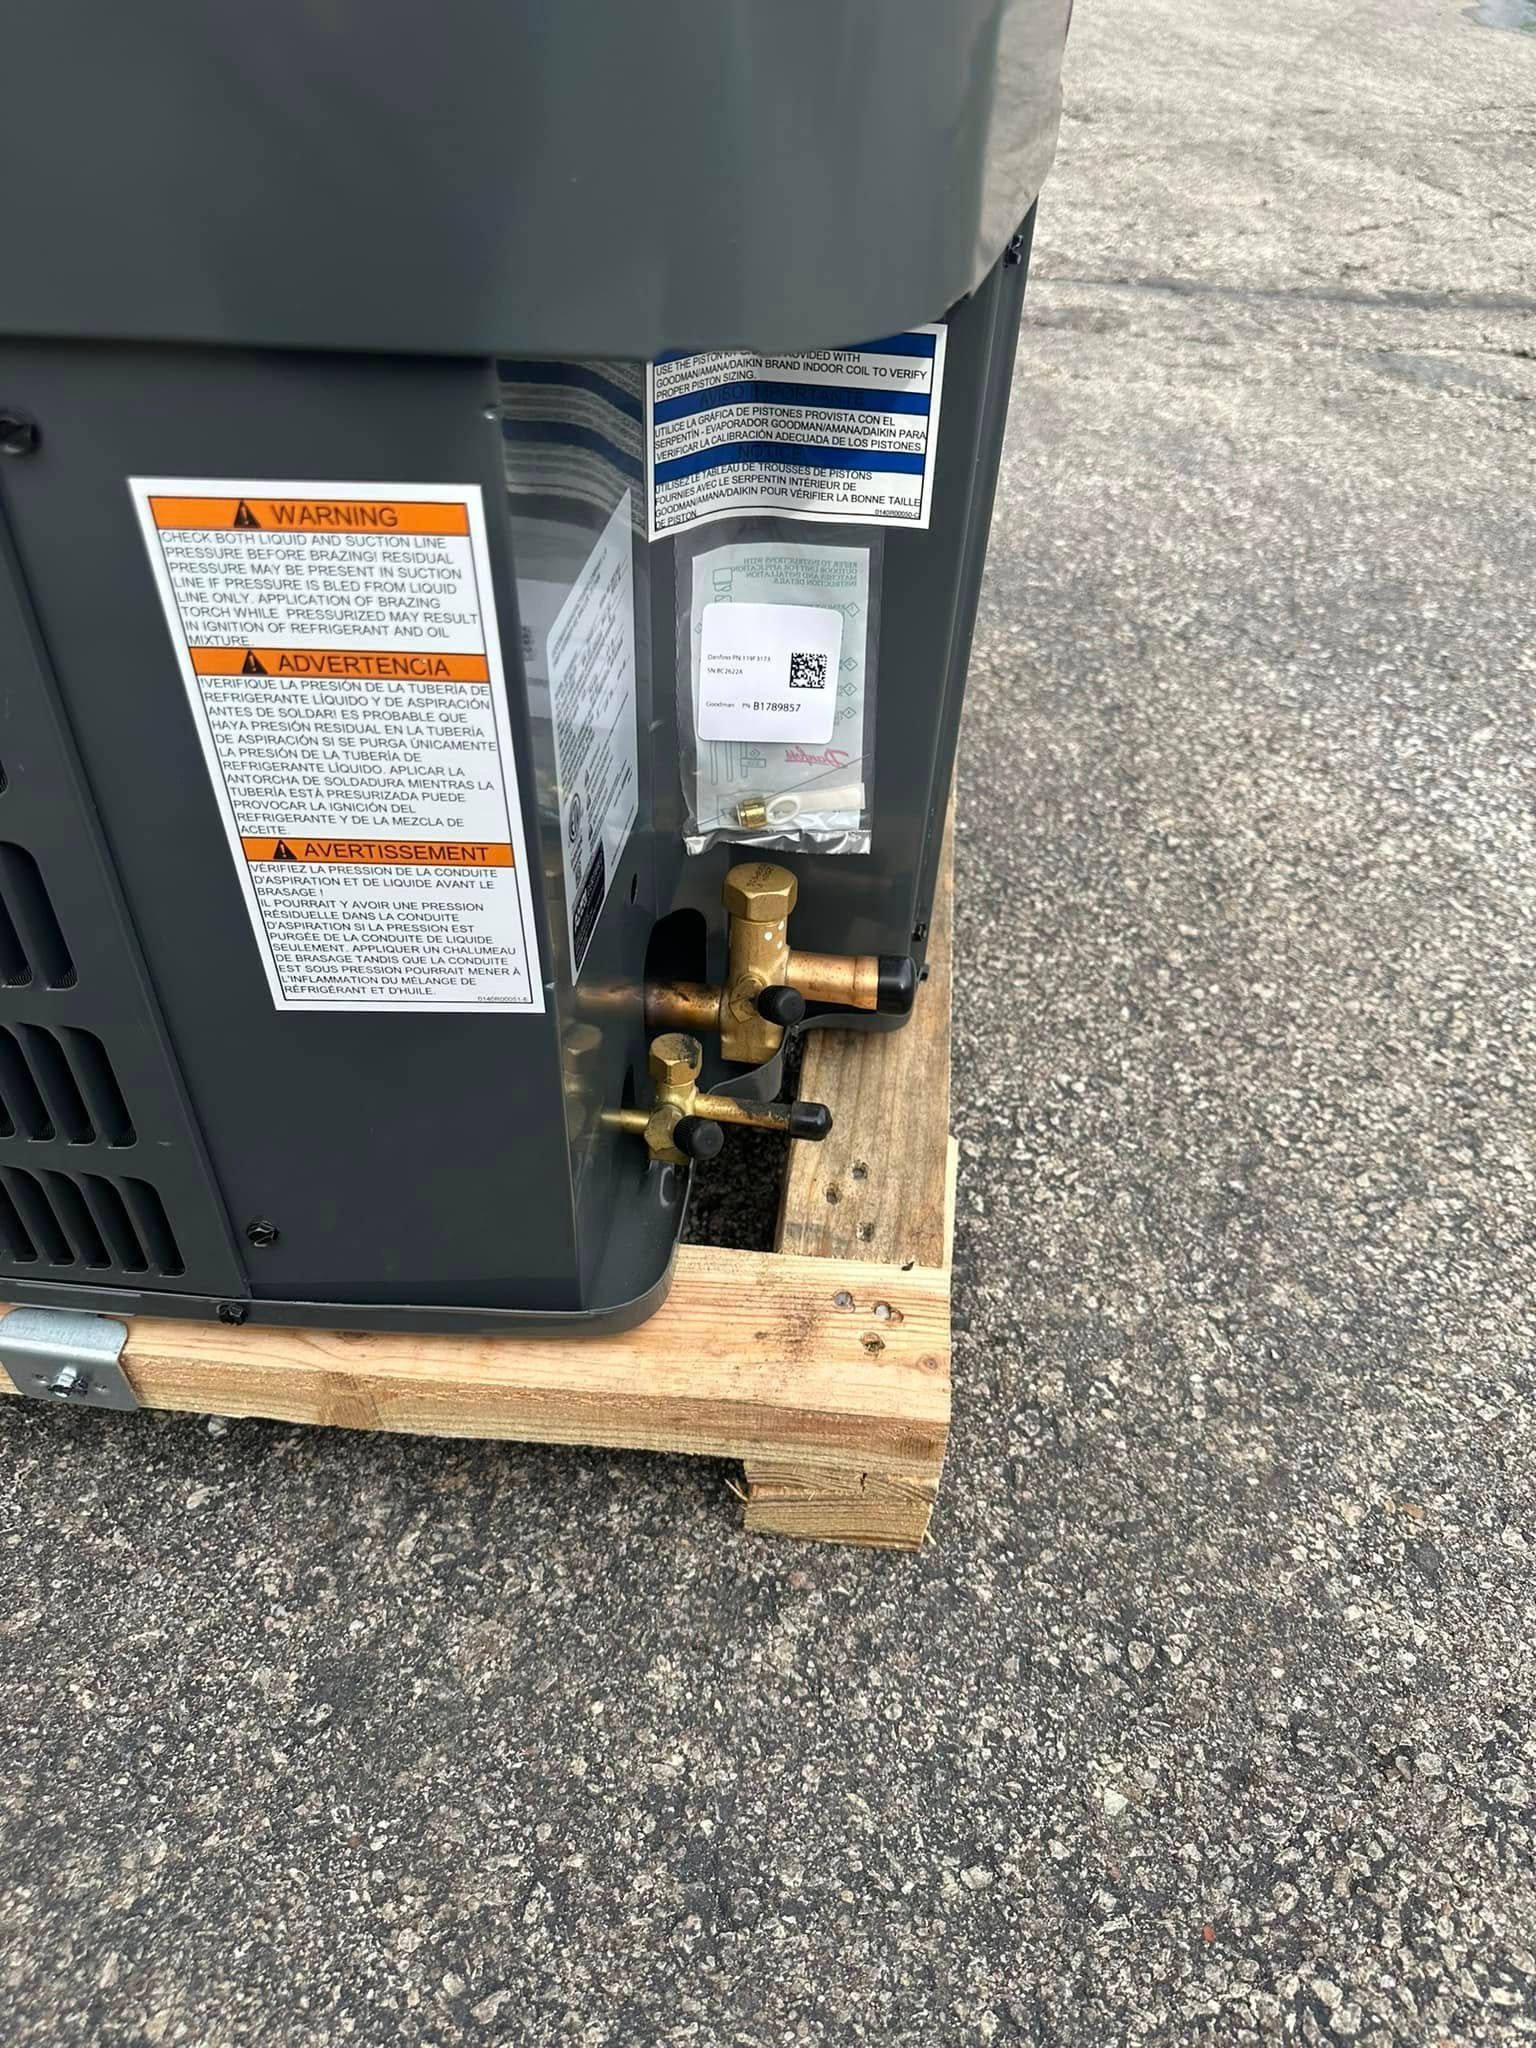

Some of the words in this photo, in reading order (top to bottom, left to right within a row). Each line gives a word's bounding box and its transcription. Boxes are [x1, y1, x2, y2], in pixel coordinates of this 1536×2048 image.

[656, 365, 673, 376] USE
[675, 360, 690, 371] THE
[693, 351, 724, 368] PISTON
[833, 352, 860, 362] WITH
[656, 359, 762, 388] GOODMAN/AMANA/DAIKIN
[765, 360, 800, 370] BRAND
[803, 362, 843, 373] INDOOR
[846, 365, 870, 376] COIL
[872, 367, 888, 377] TO
[890, 368, 928, 380] VERIFY
[656, 385, 690, 400] PROPER
[692, 376, 722, 391] PISTON
[656, 422, 685, 438] UTILICE
[686, 418, 697, 428] LA
[698, 409, 734, 425] GRÁFICA
[736, 407, 750, 416] DE
[752, 406, 802, 418] PISTONES
[805, 410, 856, 423] PROVISTA
[858, 414, 880, 424] CON
[883, 416, 895, 426] EL
[655, 429, 699, 449] SERPENTÍN
[706, 418, 768, 435] EVAPORADOR
[771, 419, 897, 438] GOODMAN/AMANA/DAIKIN
[899, 429, 927, 440] PARA
[656, 444, 699, 460] VERIFICAR
[699, 440, 710, 449] LA
[711, 430, 772, 446] CALIBRACIÓN
[775, 430, 829, 444] ADECUADA
[832, 436, 846, 445] DE
[848, 438, 868, 447] LOS
[691, 475, 701, 483] LE
[702, 464, 740, 479] TABLEAU
[742, 463, 755, 472] DE
[760, 464, 811, 475] TROUSSES
[813, 468, 826, 477] DE
[829, 470, 872, 480] PISTONS
[656, 489, 695, 505] FOURNIES
[696, 482, 717, 493] AVEC
[718, 477, 729, 486] LE
[732, 475, 786, 485] SERPENTIN
[789, 477, 841, 490] INTÉRIEUR
[842, 482, 856, 491] DE
[656, 486, 758, 518] GOODMAN/AMANA/DAIKIN
[760, 486, 788, 497] POUR
[791, 489, 834, 502] VÉRIFIER
[836, 494, 849, 503] LA
[851, 494, 885, 504] BONNE
[888, 496, 921, 507] TAILLE
[271, 505, 397, 526] WARNING
[668, 511, 697, 525] PISTON
[161, 531, 211, 543] CHECK
[214, 532, 255, 544] BOTH
[258, 533, 307, 545] LIQUID
[311, 534, 341, 546] AND
[345, 535, 410, 547] SUCTION
[413, 537, 446, 549] LINE
[165, 546, 242, 559] PRESSURE
[247, 548, 306, 560] BEFORE
[309, 549, 376, 562] BRAZING!
[382, 551, 453, 564] RESIDUAL
[169, 562, 246, 574] PRESSURE
[250, 563, 280, 574] MAY
[284, 564, 304, 575] BE
[308, 564, 373, 577] PRESENT
[379, 566, 394, 577] IN
[397, 567, 461, 579] SUCTION
[181, 606, 230, 617] TORCH
[233, 607, 278, 619] WHILE
[286, 608, 385, 621] PRESSURIZED
[389, 611, 418, 622] MAY
[423, 612, 476, 624] RESULT
[184, 620, 199, 631] IN
[202, 621, 264, 632] IGNITION
[267, 622, 285, 633] OF
[290, 623, 387, 635] REFRIGERANT
[394, 625, 423, 637] AND
[426, 626, 449, 638] OIL
[279, 654, 449, 675] ADVERTENCIA
[279, 680, 298, 690] LA
[300, 680, 361, 691] PRESIÓN
[364, 682, 384, 692] DE
[387, 683, 405, 693] LA
[407, 683, 467, 694] TUBERÍA
[470, 685, 489, 696] DE
[204, 692, 308, 704] REFRIGERANTE
[312, 694, 368, 706] LÍQUIDO
[371, 696, 380, 706] Y
[384, 696, 403, 707] DE
[407, 697, 489, 709] ASPIRACIÓN
[753, 701, 801, 712] B1789857
[230, 786, 286, 797] TUBERÍA
[288, 787, 324, 798] ESTÁ
[326, 789, 418, 800] PRESURIZADA
[421, 792, 465, 802] PUEDE
[305, 843, 490, 860] AVERTISSEMENT
[251, 863, 306, 873] VÉRIFIEZ
[309, 865, 326, 873] LA
[328, 865, 392, 875] PRESSION
[395, 866, 412, 876] DE
[415, 867, 431, 876] LA
[434, 867, 497, 877] CONDUITE
[263, 909, 338, 919] RÉSIDUELLE
[342, 911, 376, 920] DANS
[378, 912, 394, 920] LA
[396, 912, 459, 922] CONDUITE
[352, 944, 419, 953] APPLIQUER
[422, 946, 440, 954] UN
[442, 946, 515, 955] CHALUMEAU
[284, 984, 365, 994] RÉFRIGÉRANT
[370, 986, 384, 994] ET
[380, 976, 398, 984] DU
[401, 976, 456, 985] MÉLANGE
[460, 977, 476, 985] DE
